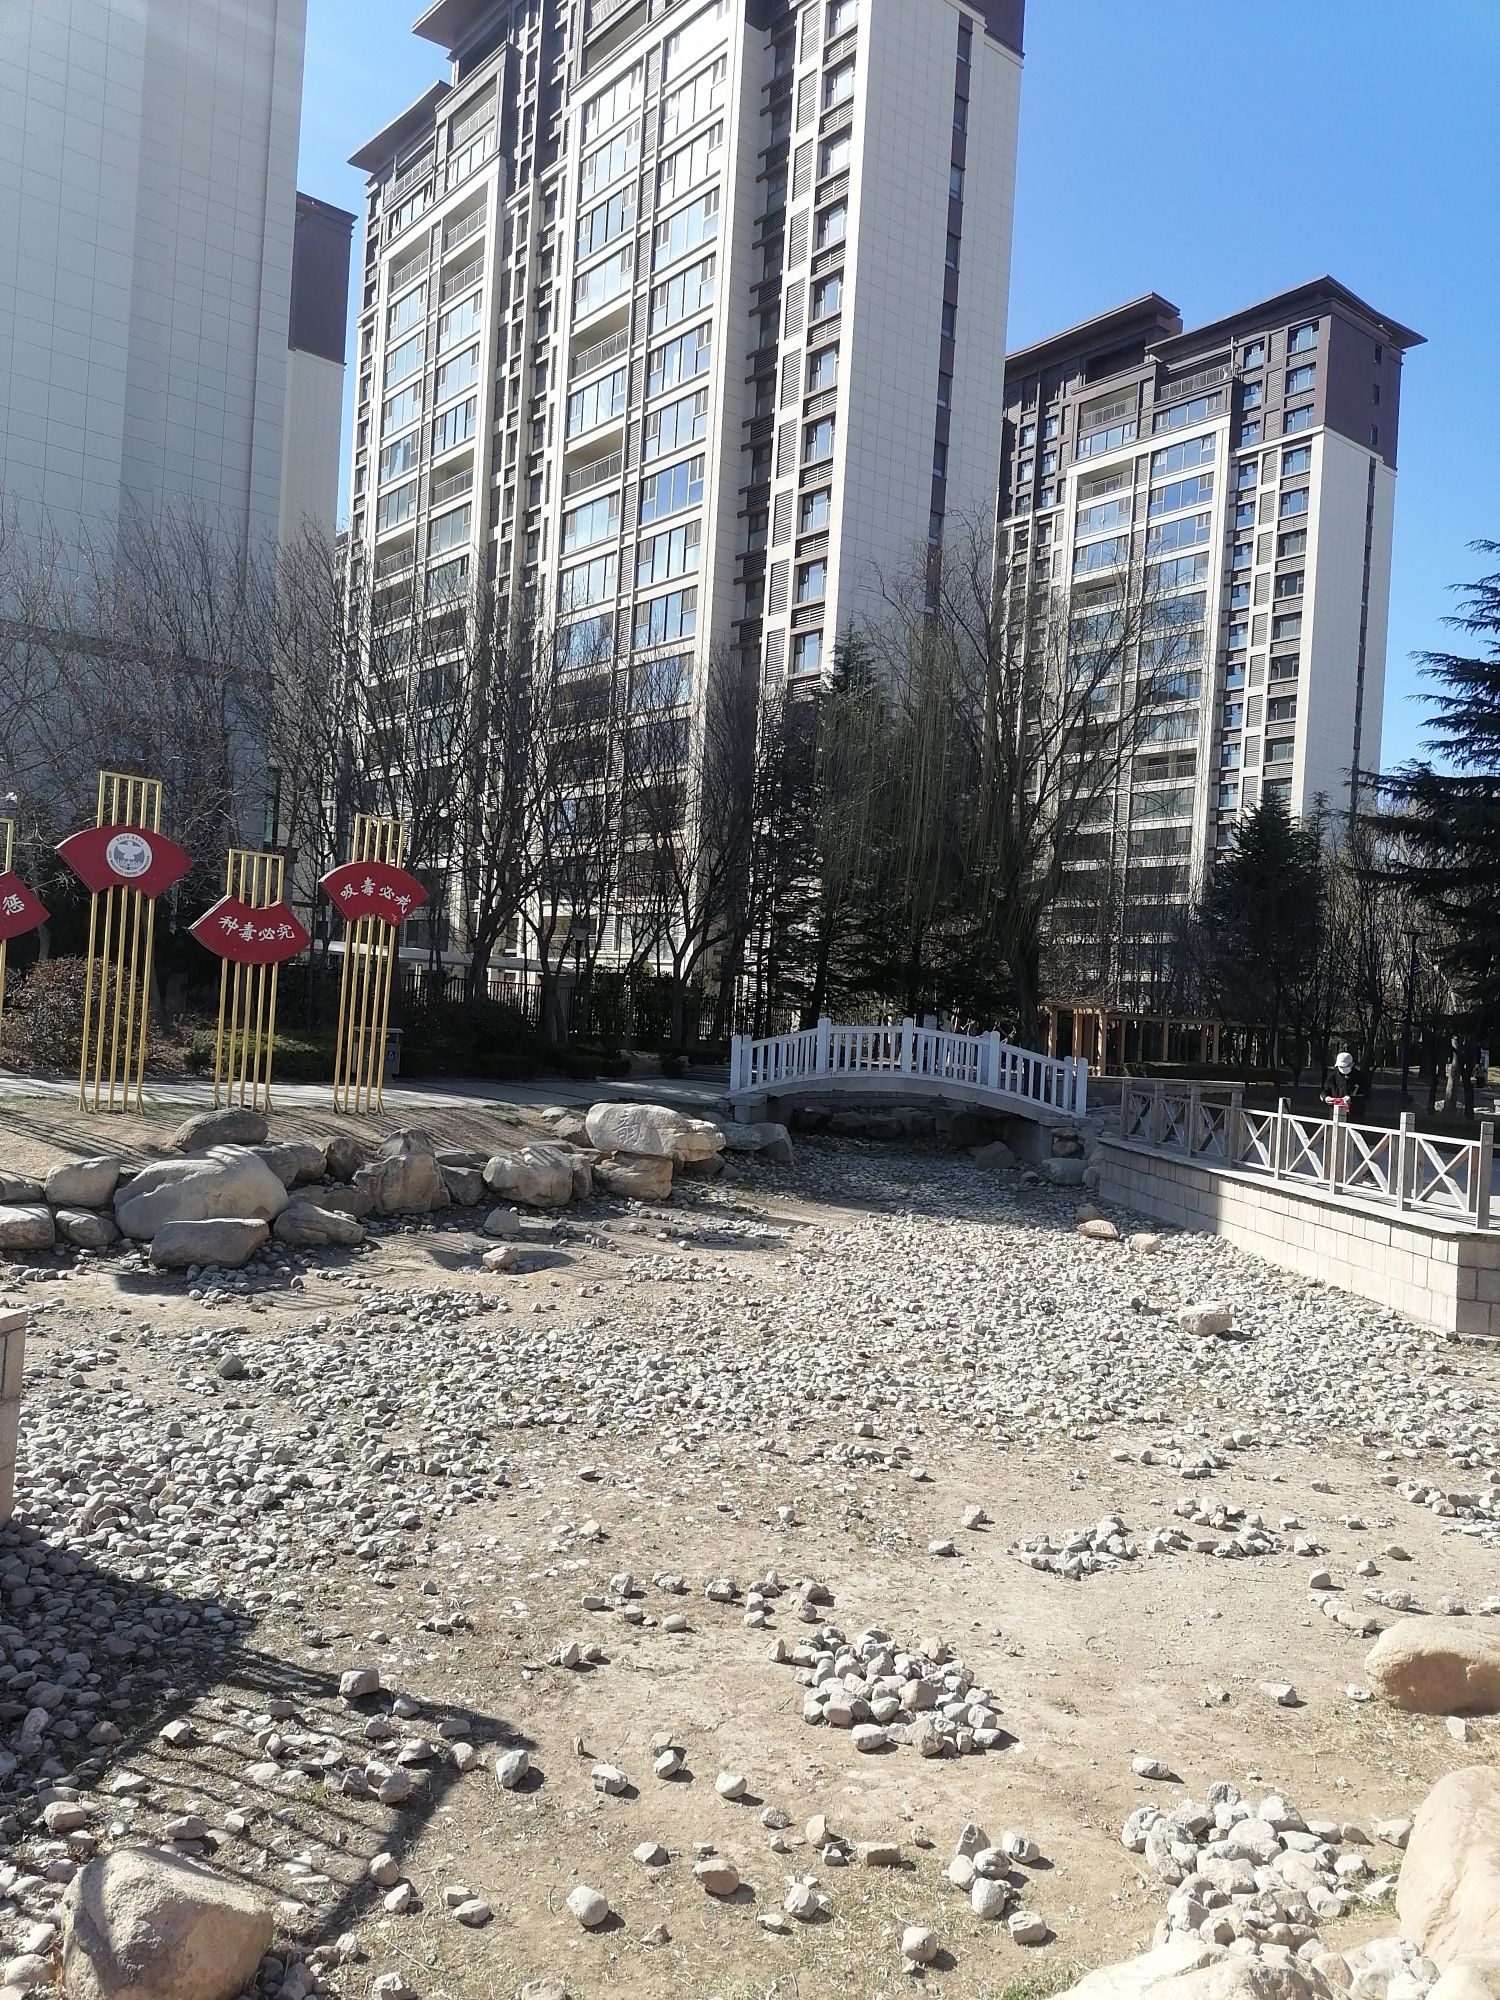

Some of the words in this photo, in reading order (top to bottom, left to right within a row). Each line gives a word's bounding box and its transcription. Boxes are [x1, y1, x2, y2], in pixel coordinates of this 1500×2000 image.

[2, 893, 25, 916] 惩
[340, 877, 411, 914] 吸毒必戒
[218, 915, 296, 942] 种毒必究
